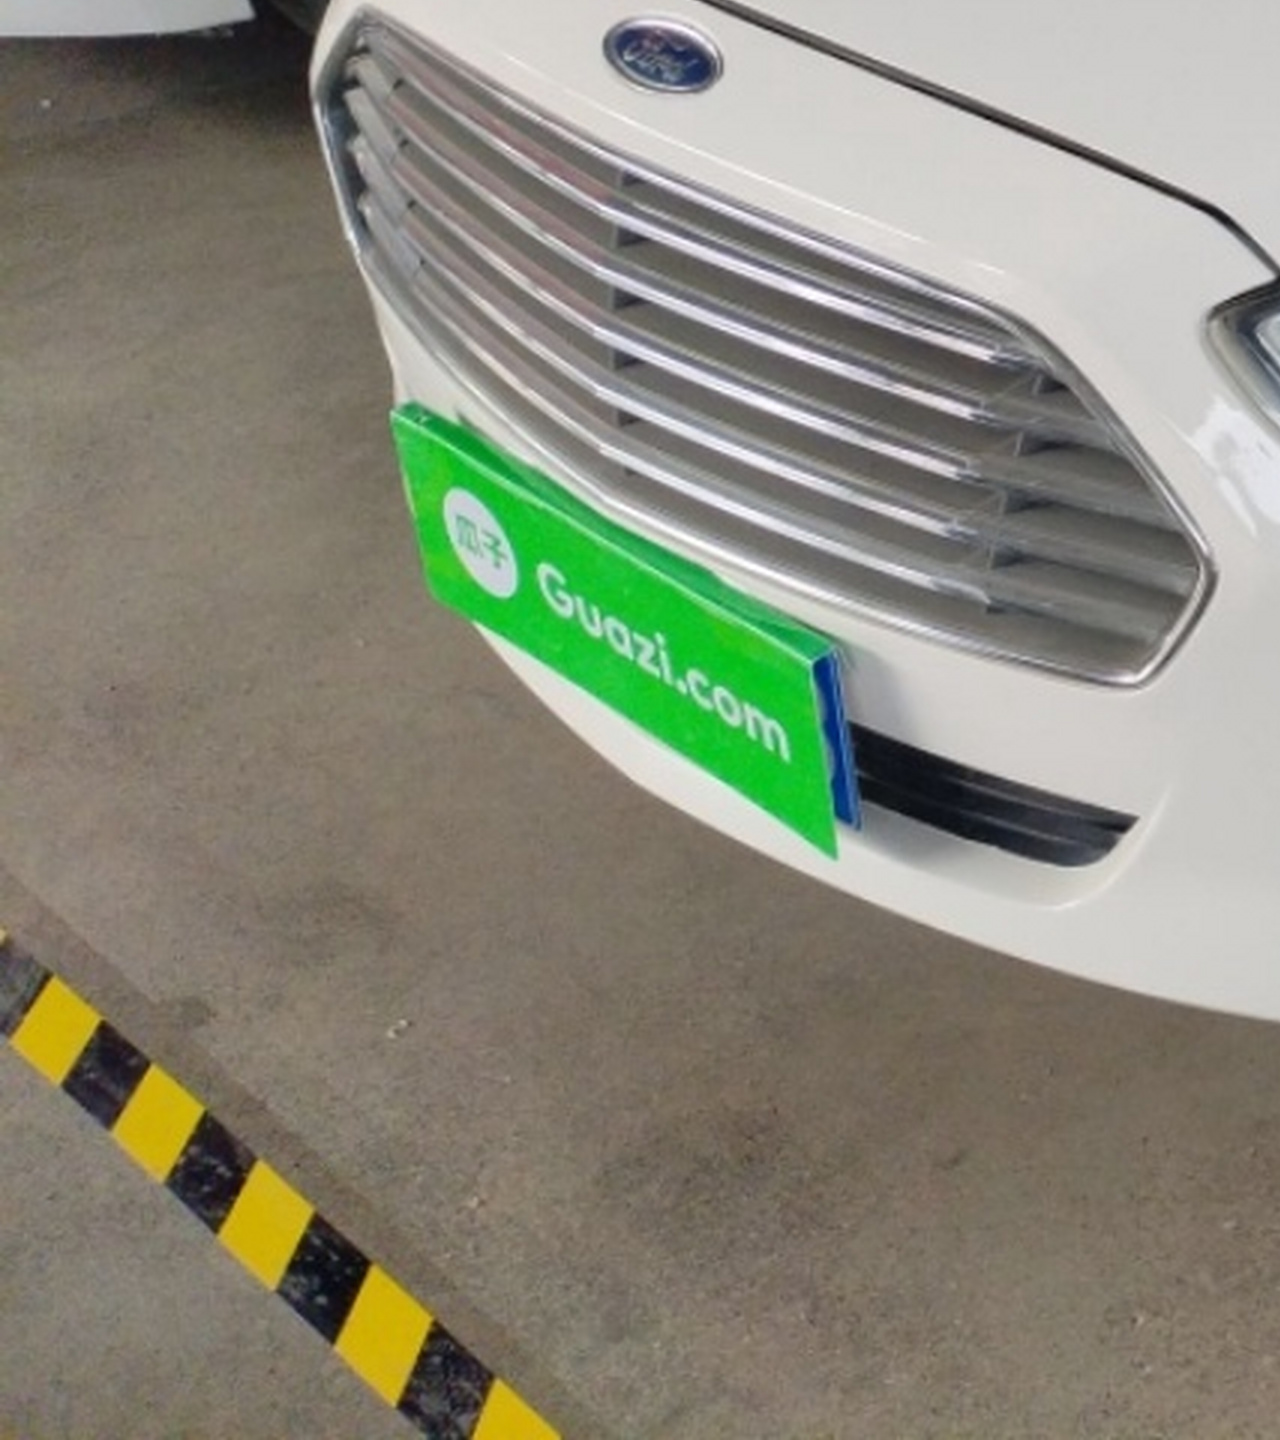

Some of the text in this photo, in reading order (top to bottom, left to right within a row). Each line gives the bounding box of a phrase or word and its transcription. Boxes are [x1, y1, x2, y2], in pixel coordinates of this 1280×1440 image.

[622, 28, 701, 82] Ford
[455, 513, 508, 571] 瓜子
[536, 561, 791, 764] Guazi.com
